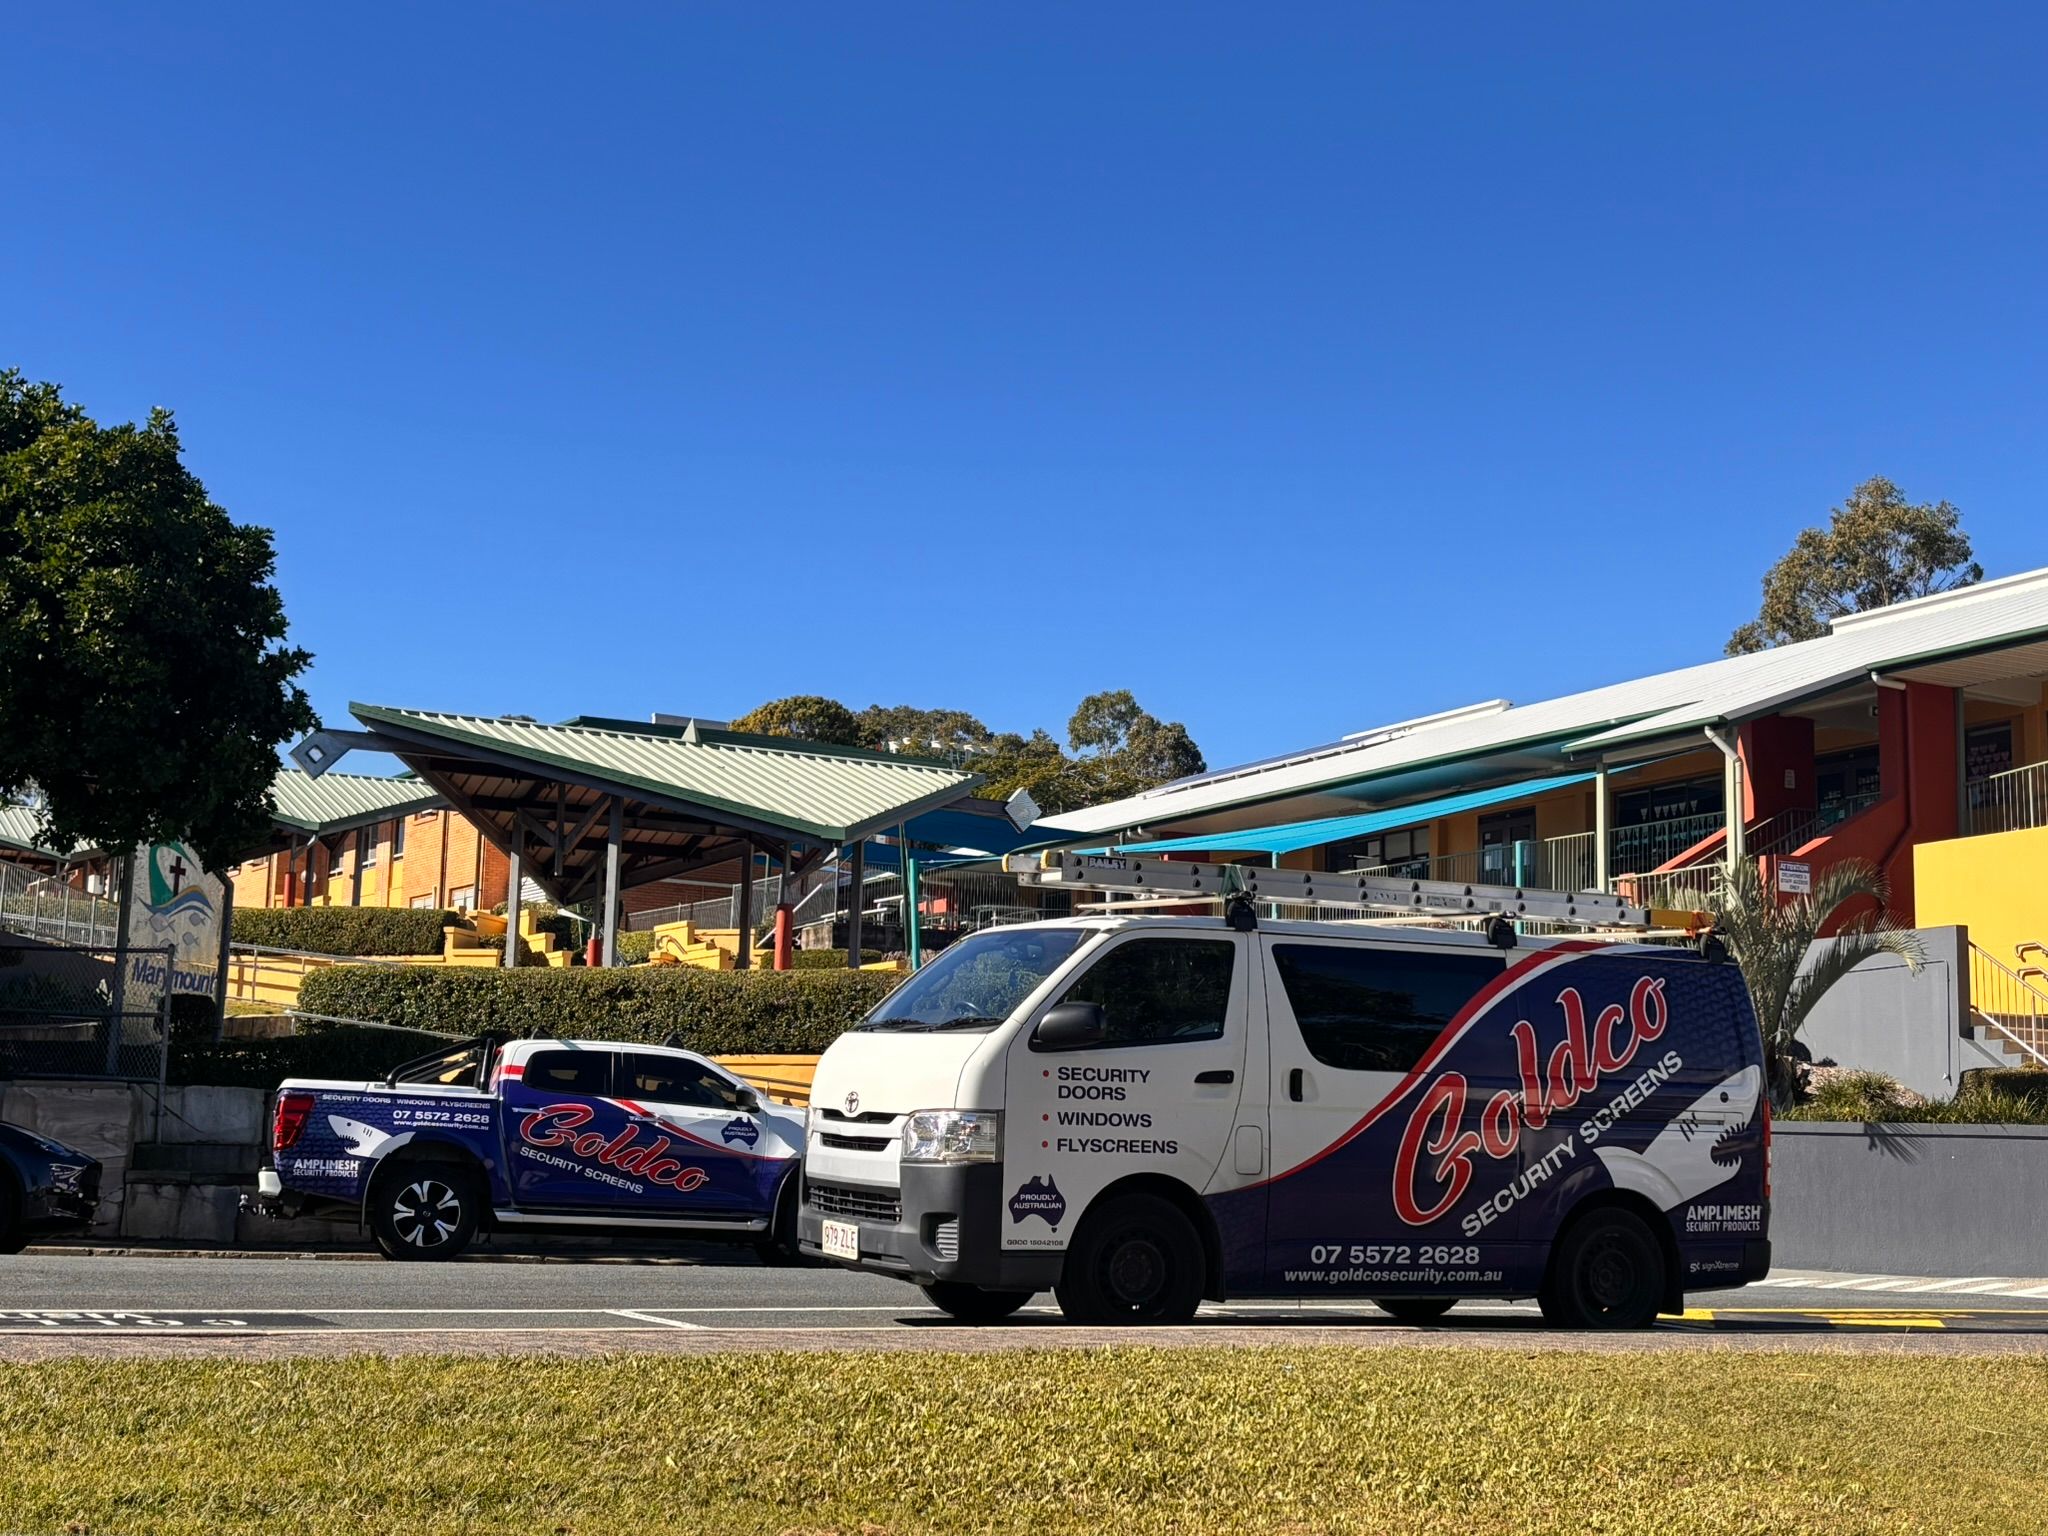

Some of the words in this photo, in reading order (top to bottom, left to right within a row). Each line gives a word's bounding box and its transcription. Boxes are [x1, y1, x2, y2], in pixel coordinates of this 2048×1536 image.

[1088, 857, 1126, 869] BAILEY
[1057, 1066, 1151, 1083] SECURITY
[1058, 1085, 1127, 1101] DOORS
[1392, 975, 1668, 1227] Goldco
[322, 1094, 361, 1102] SECURITY
[362, 1096, 391, 1104] DOORS
[397, 1098, 436, 1106] WINDOWS
[440, 1101, 491, 1110] FLYSCREENS
[393, 1110, 410, 1119] 07
[414, 1111, 450, 1121] 5572
[453, 1113, 490, 1124] 2628
[1057, 1111, 1152, 1128] WINDOWS
[393, 1120, 489, 1131] www.goldcosecurity.com.au
[519, 1103, 710, 1191] Goldco
[1057, 1138, 1178, 1154] FLYSCREENS
[1461, 1134, 1577, 1238] SECURITY
[1579, 1050, 1684, 1144] SCREENS
[293, 1158, 359, 1171] AMPLIMESH
[520, 1146, 583, 1174] SECURITY
[583, 1168, 644, 1194] SCREENS
[293, 1168, 323, 1177] SECURITY
[324, 1169, 358, 1178] PRODUCTS
[1020, 1193, 1057, 1201] PROUDLY
[1686, 1205, 1761, 1221] AMPLIMESH
[1686, 1221, 1721, 1232] SECURITY
[1722, 1221, 1760, 1232] PRODUCTS
[824, 1225, 839, 1246] 979
[840, 1228, 856, 1250] ZLE
[1310, 1245, 1342, 1265] 07
[1349, 1246, 1411, 1265] 5572
[1418, 1246, 1480, 1265] 2628
[1284, 1268, 1503, 1285] www.goldcosecurity.com.au
